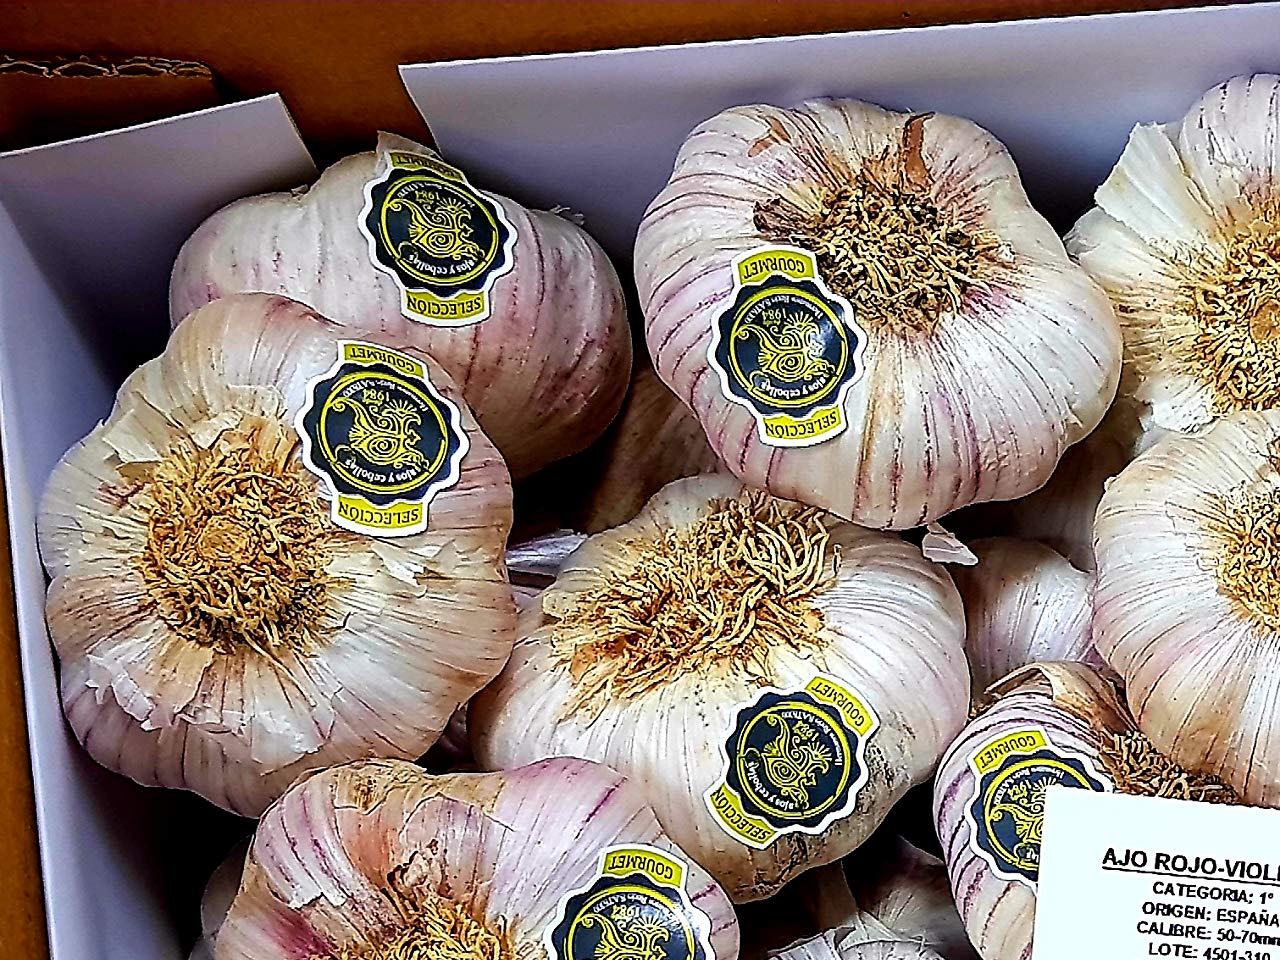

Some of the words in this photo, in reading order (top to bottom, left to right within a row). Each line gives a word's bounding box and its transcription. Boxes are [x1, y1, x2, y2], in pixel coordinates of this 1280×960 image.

[742, 257, 805, 279] GOURMET
[350, 348, 414, 372] GOURMET
[811, 683, 865, 726] GOURMET
[981, 736, 1035, 768] GOURMET
[609, 856, 672, 878] GOURMET
[1102, 848, 1147, 868] AJO
[1142, 901, 1211, 921] ORIGEN:
[1217, 909, 1280, 927] ESPAÑA
[1137, 921, 1211, 940] CALIBRE:
[1149, 942, 1198, 958] LOTE:
